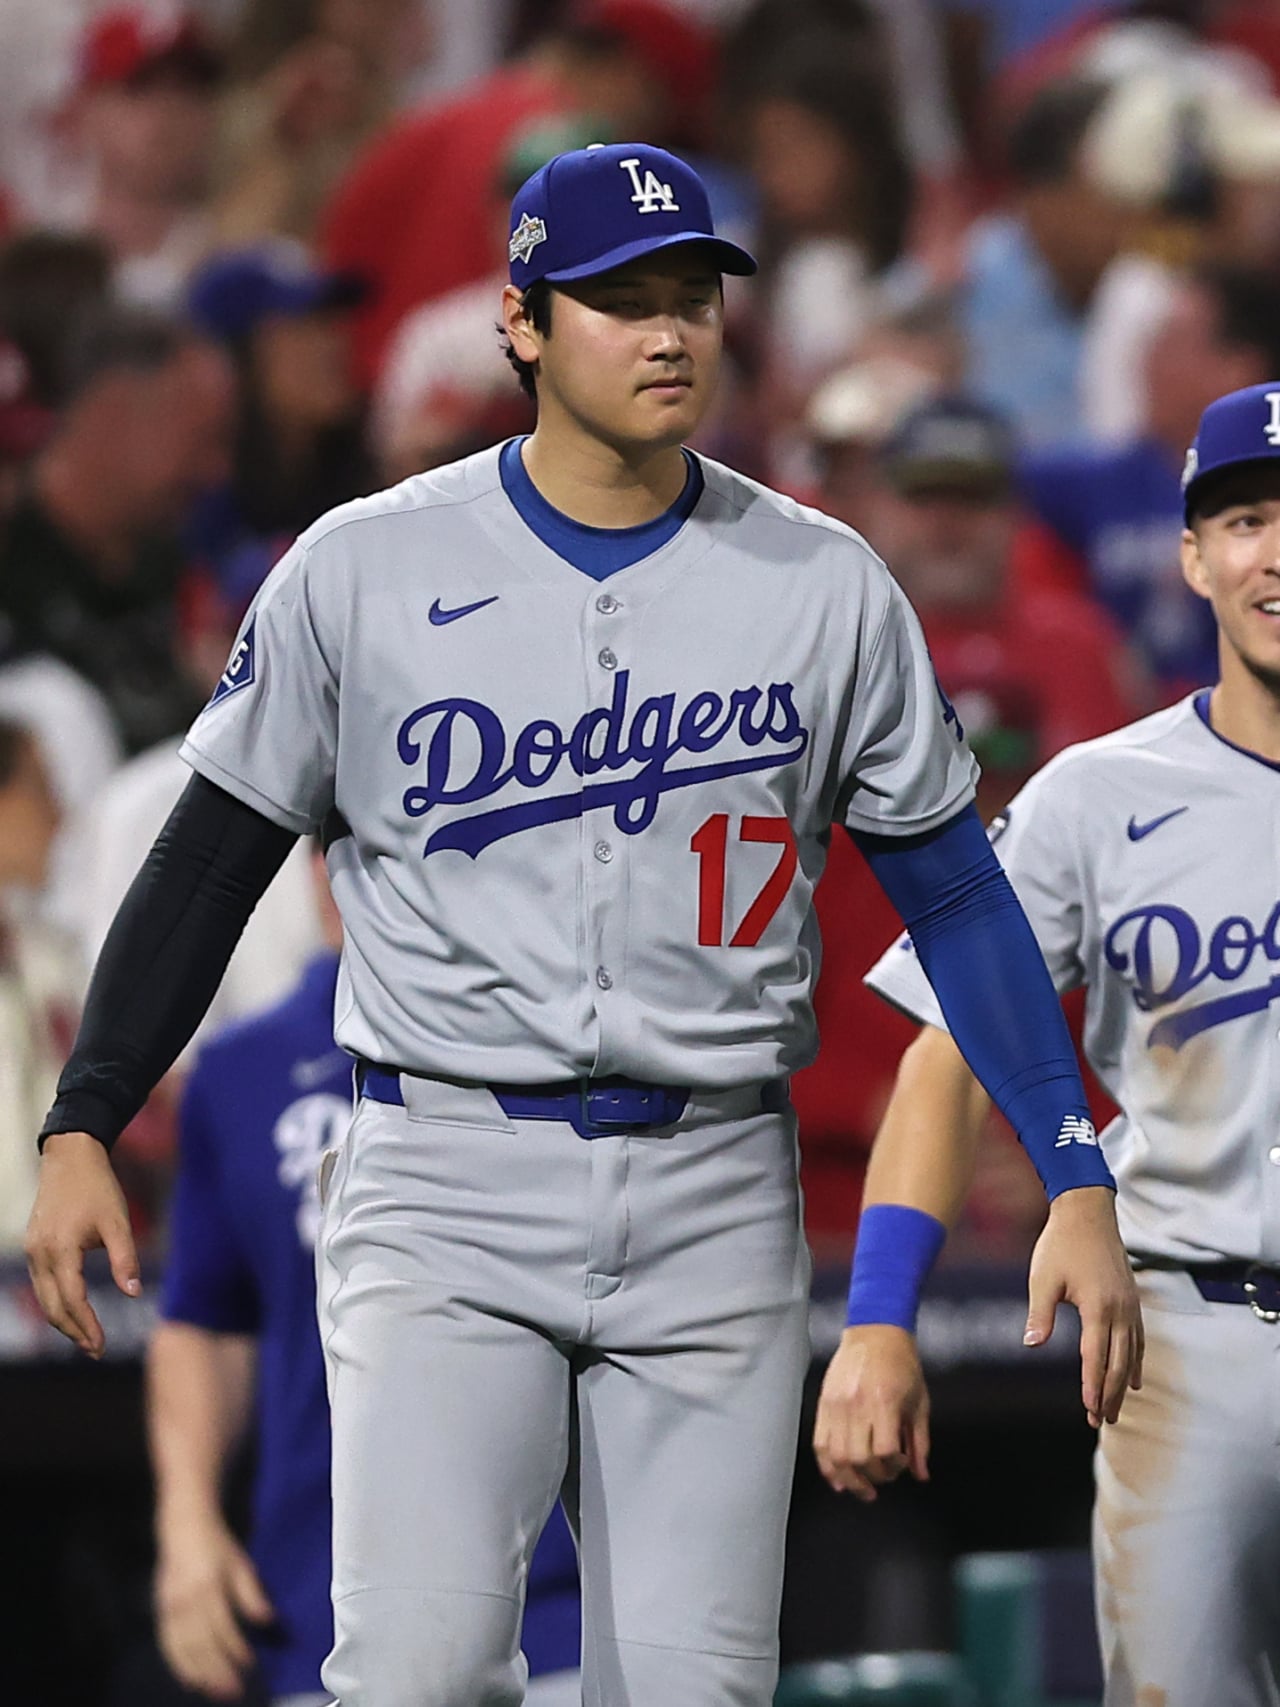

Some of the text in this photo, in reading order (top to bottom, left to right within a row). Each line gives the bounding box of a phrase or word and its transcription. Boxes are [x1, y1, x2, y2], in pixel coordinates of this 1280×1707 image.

[620, 159, 680, 213] LA
[397, 669, 808, 835] Dodgers
[690, 813, 798, 947] 17
